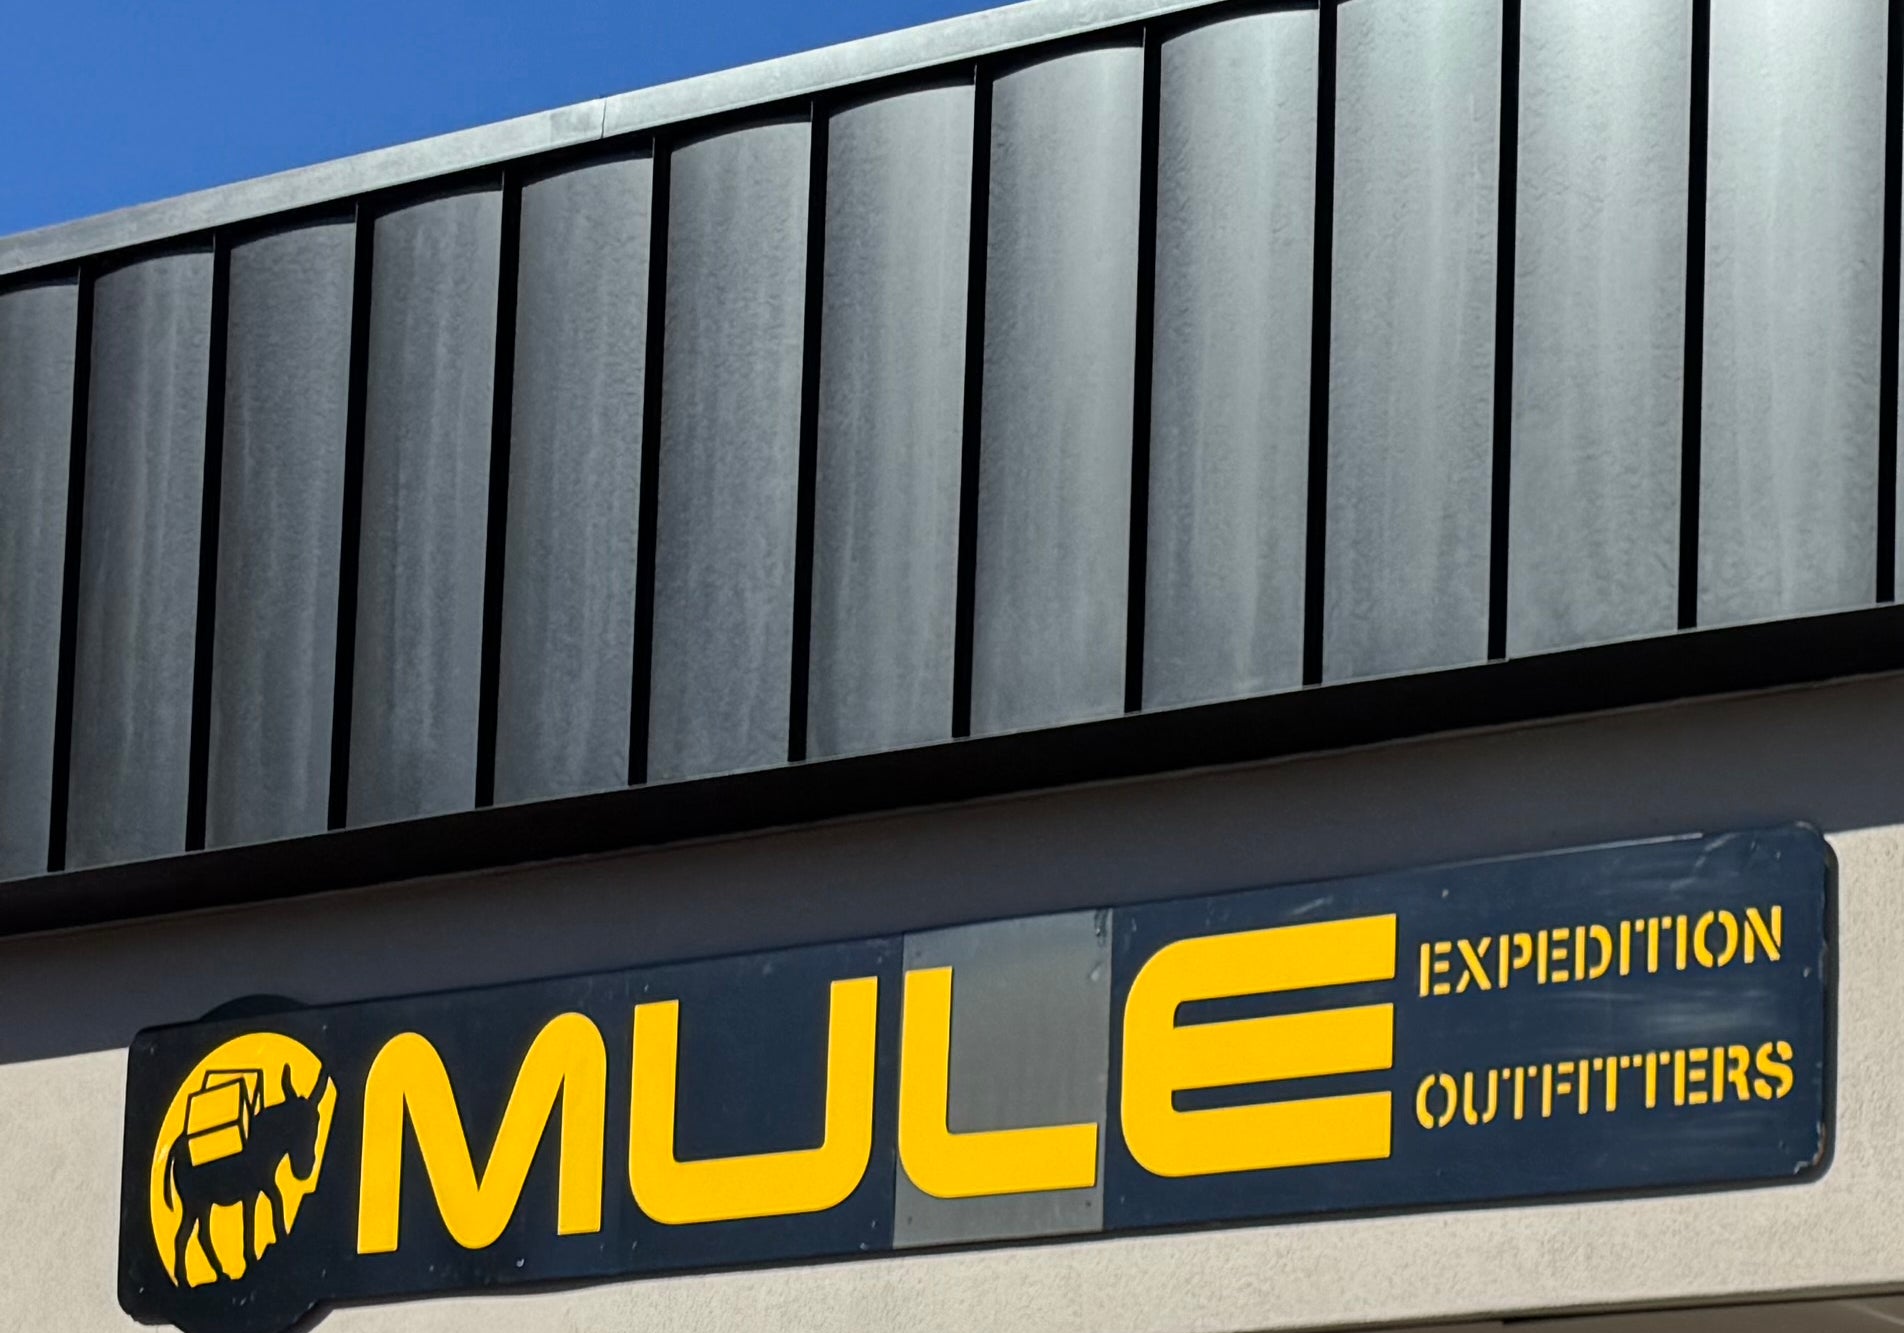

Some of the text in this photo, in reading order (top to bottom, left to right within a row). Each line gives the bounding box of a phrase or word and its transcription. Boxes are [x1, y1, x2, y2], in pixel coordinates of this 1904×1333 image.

[1420, 907, 1784, 997] EXPEDITION
[356, 914, 1399, 1256] MULE
[1415, 1042, 1796, 1130] OUTFITTERS
